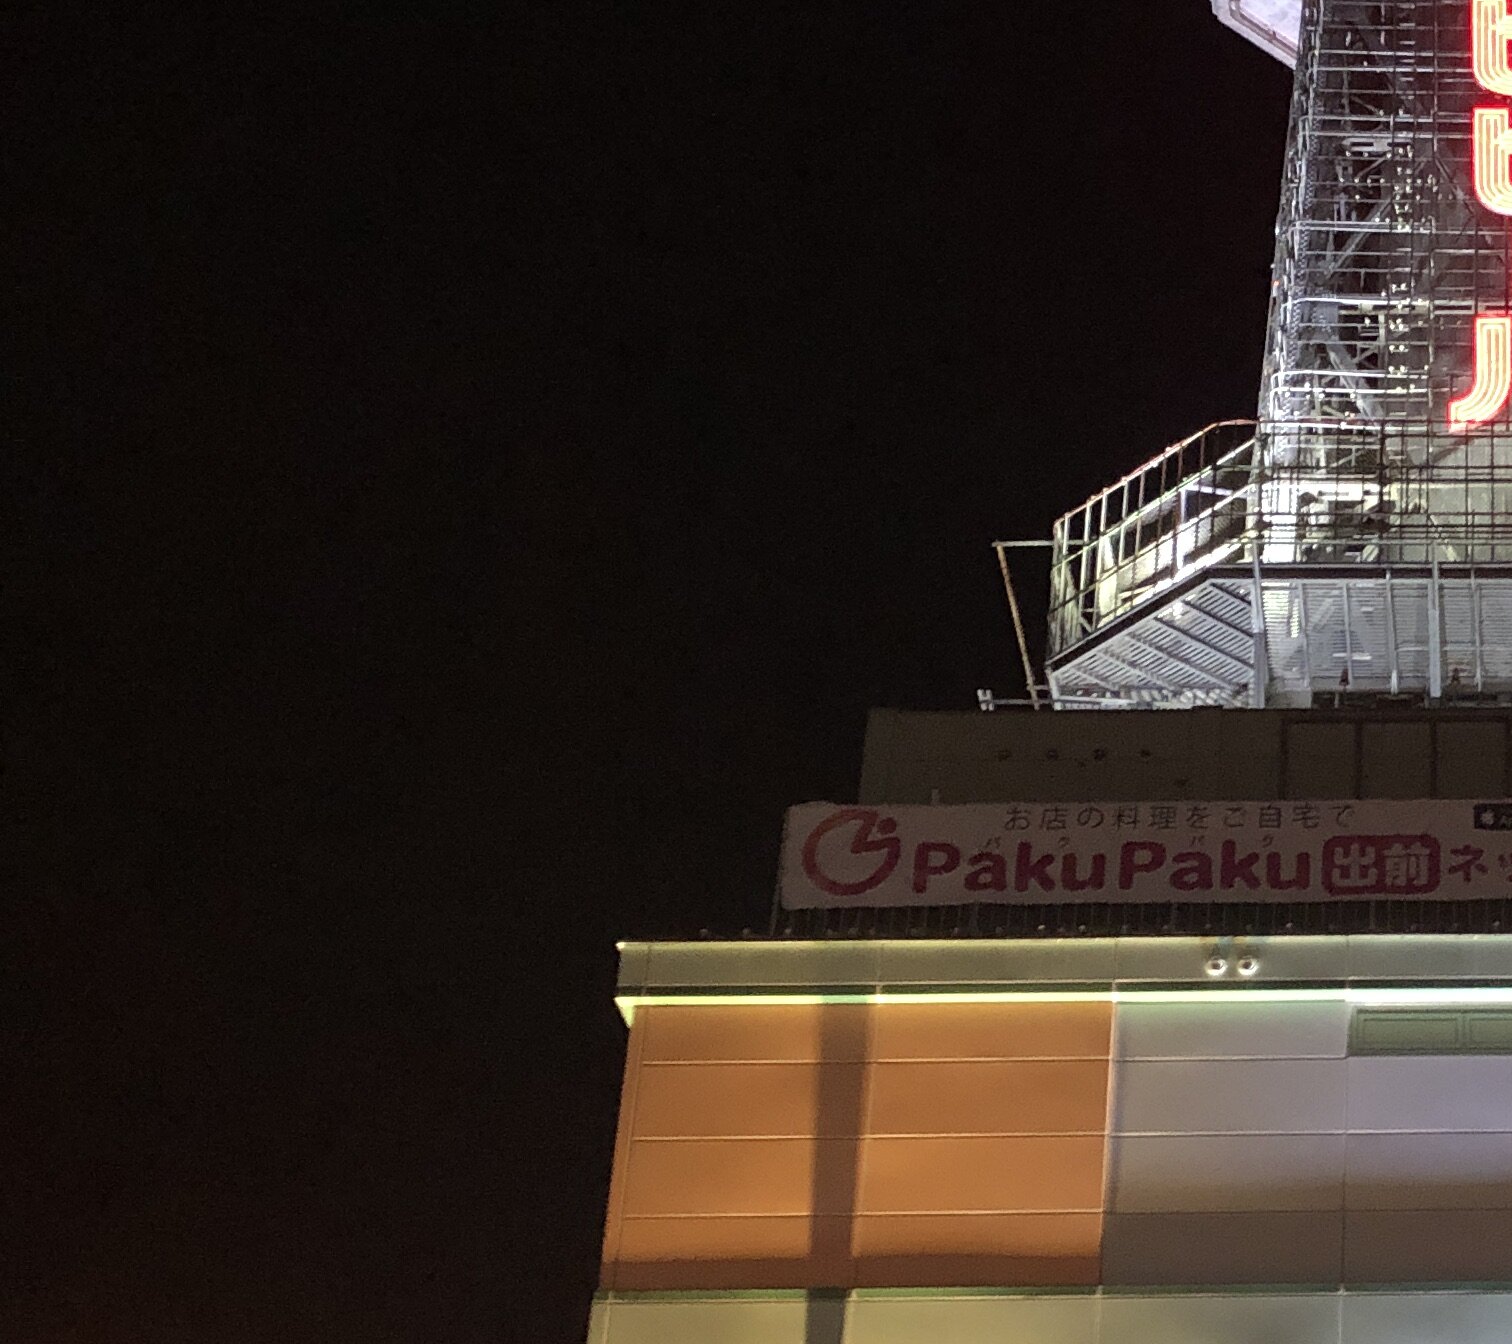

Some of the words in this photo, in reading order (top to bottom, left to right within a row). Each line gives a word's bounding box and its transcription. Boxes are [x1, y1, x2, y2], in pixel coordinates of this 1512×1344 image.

[1004, 803, 1357, 831] お店の料理をご自宅で
[911, 838, 1311, 895] PakuPaku
[1331, 843, 1432, 888] 出前
